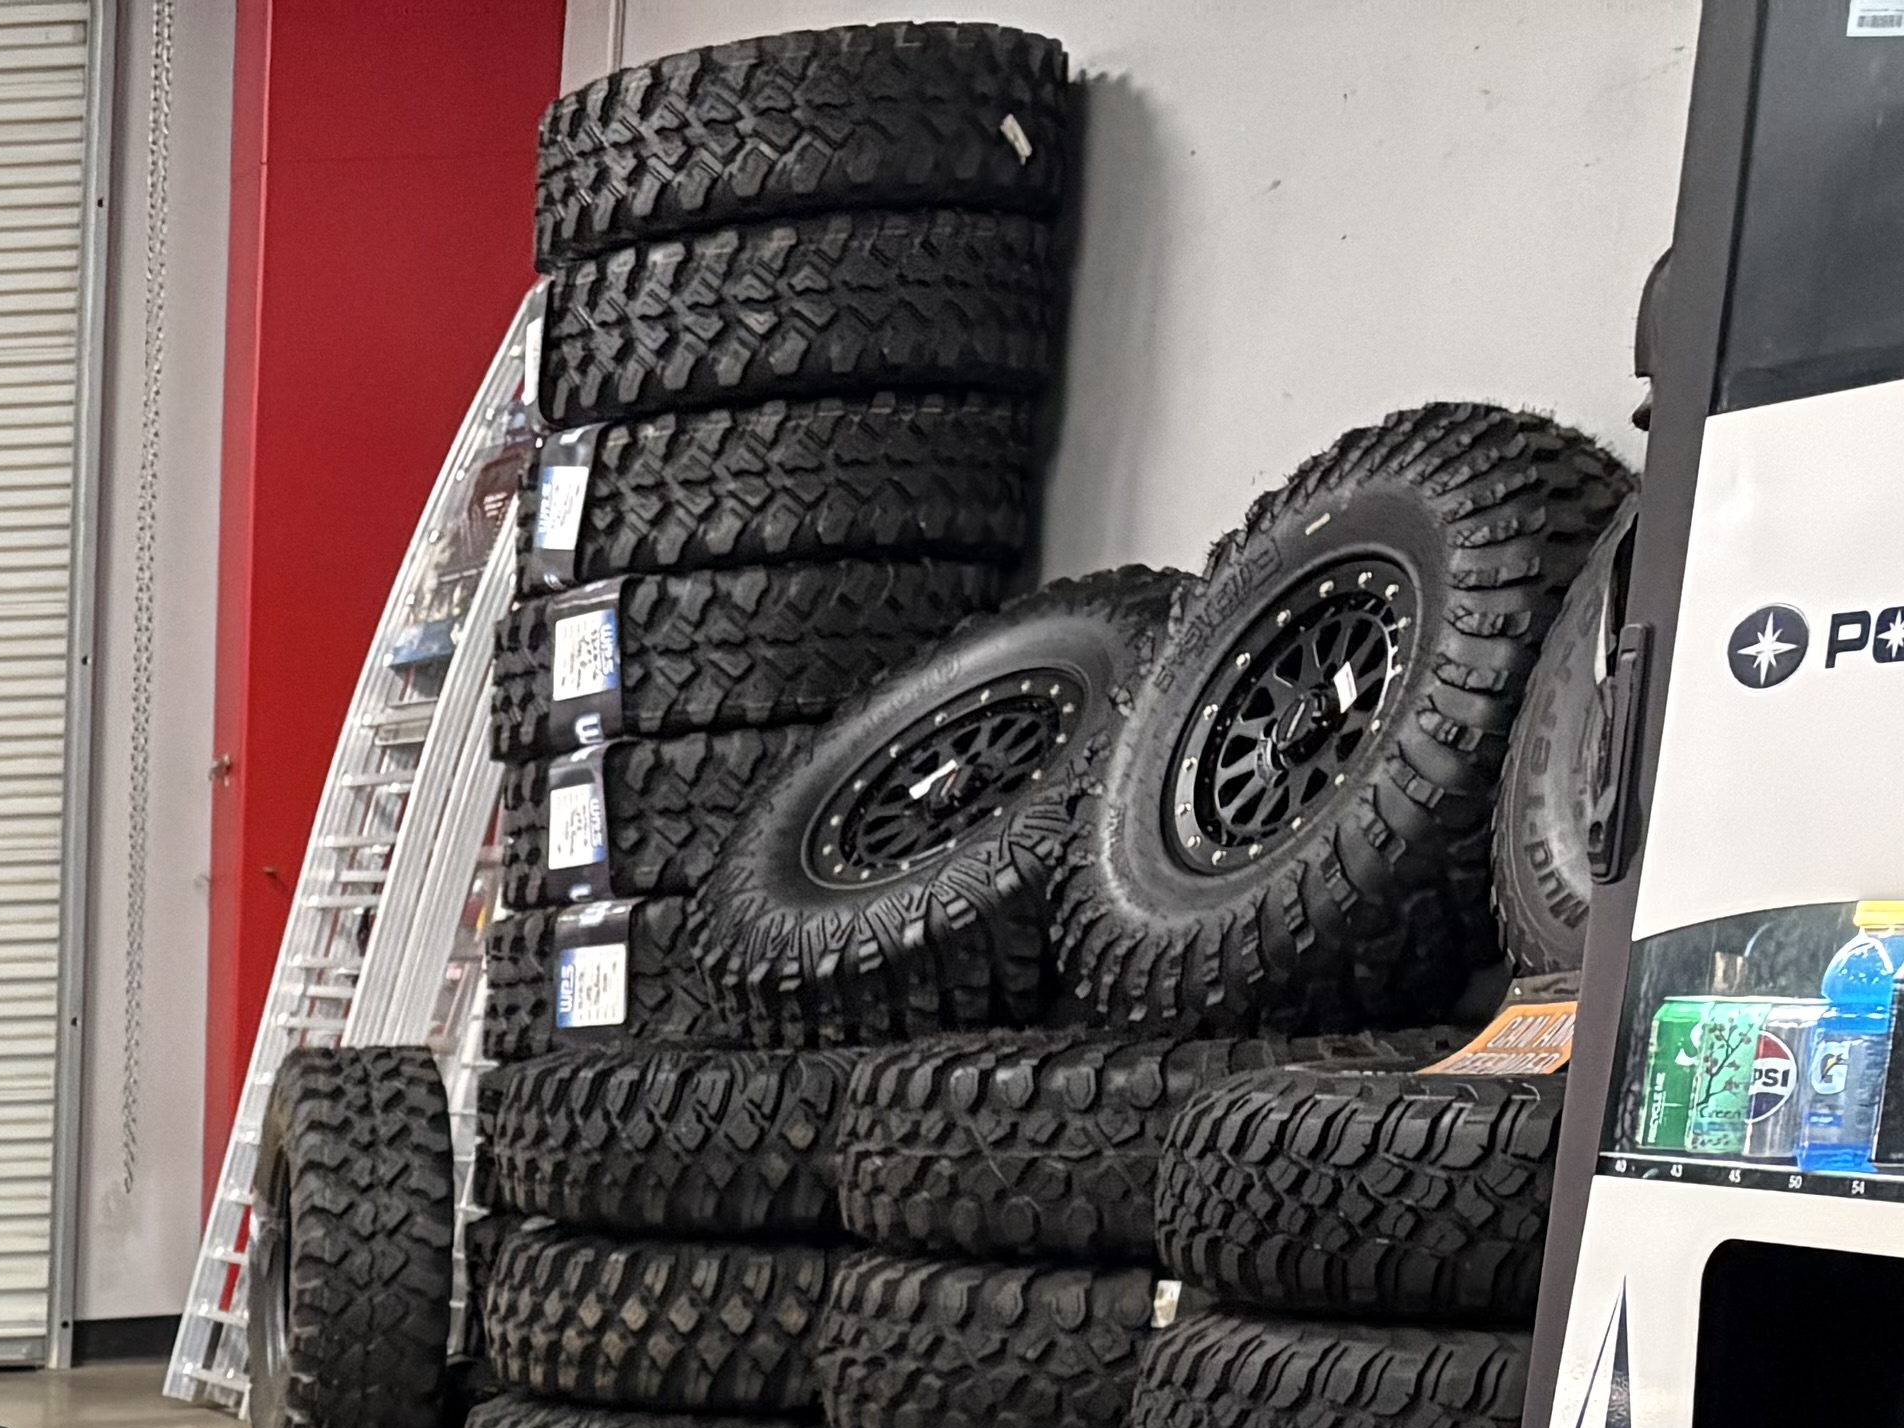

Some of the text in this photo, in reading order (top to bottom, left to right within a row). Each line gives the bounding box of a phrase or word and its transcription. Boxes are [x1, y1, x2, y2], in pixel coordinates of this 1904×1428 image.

[1487, 1016, 1551, 1048] CAN
[1752, 1067, 1791, 1088] PSI
[1789, 1174, 1803, 1189] 50
